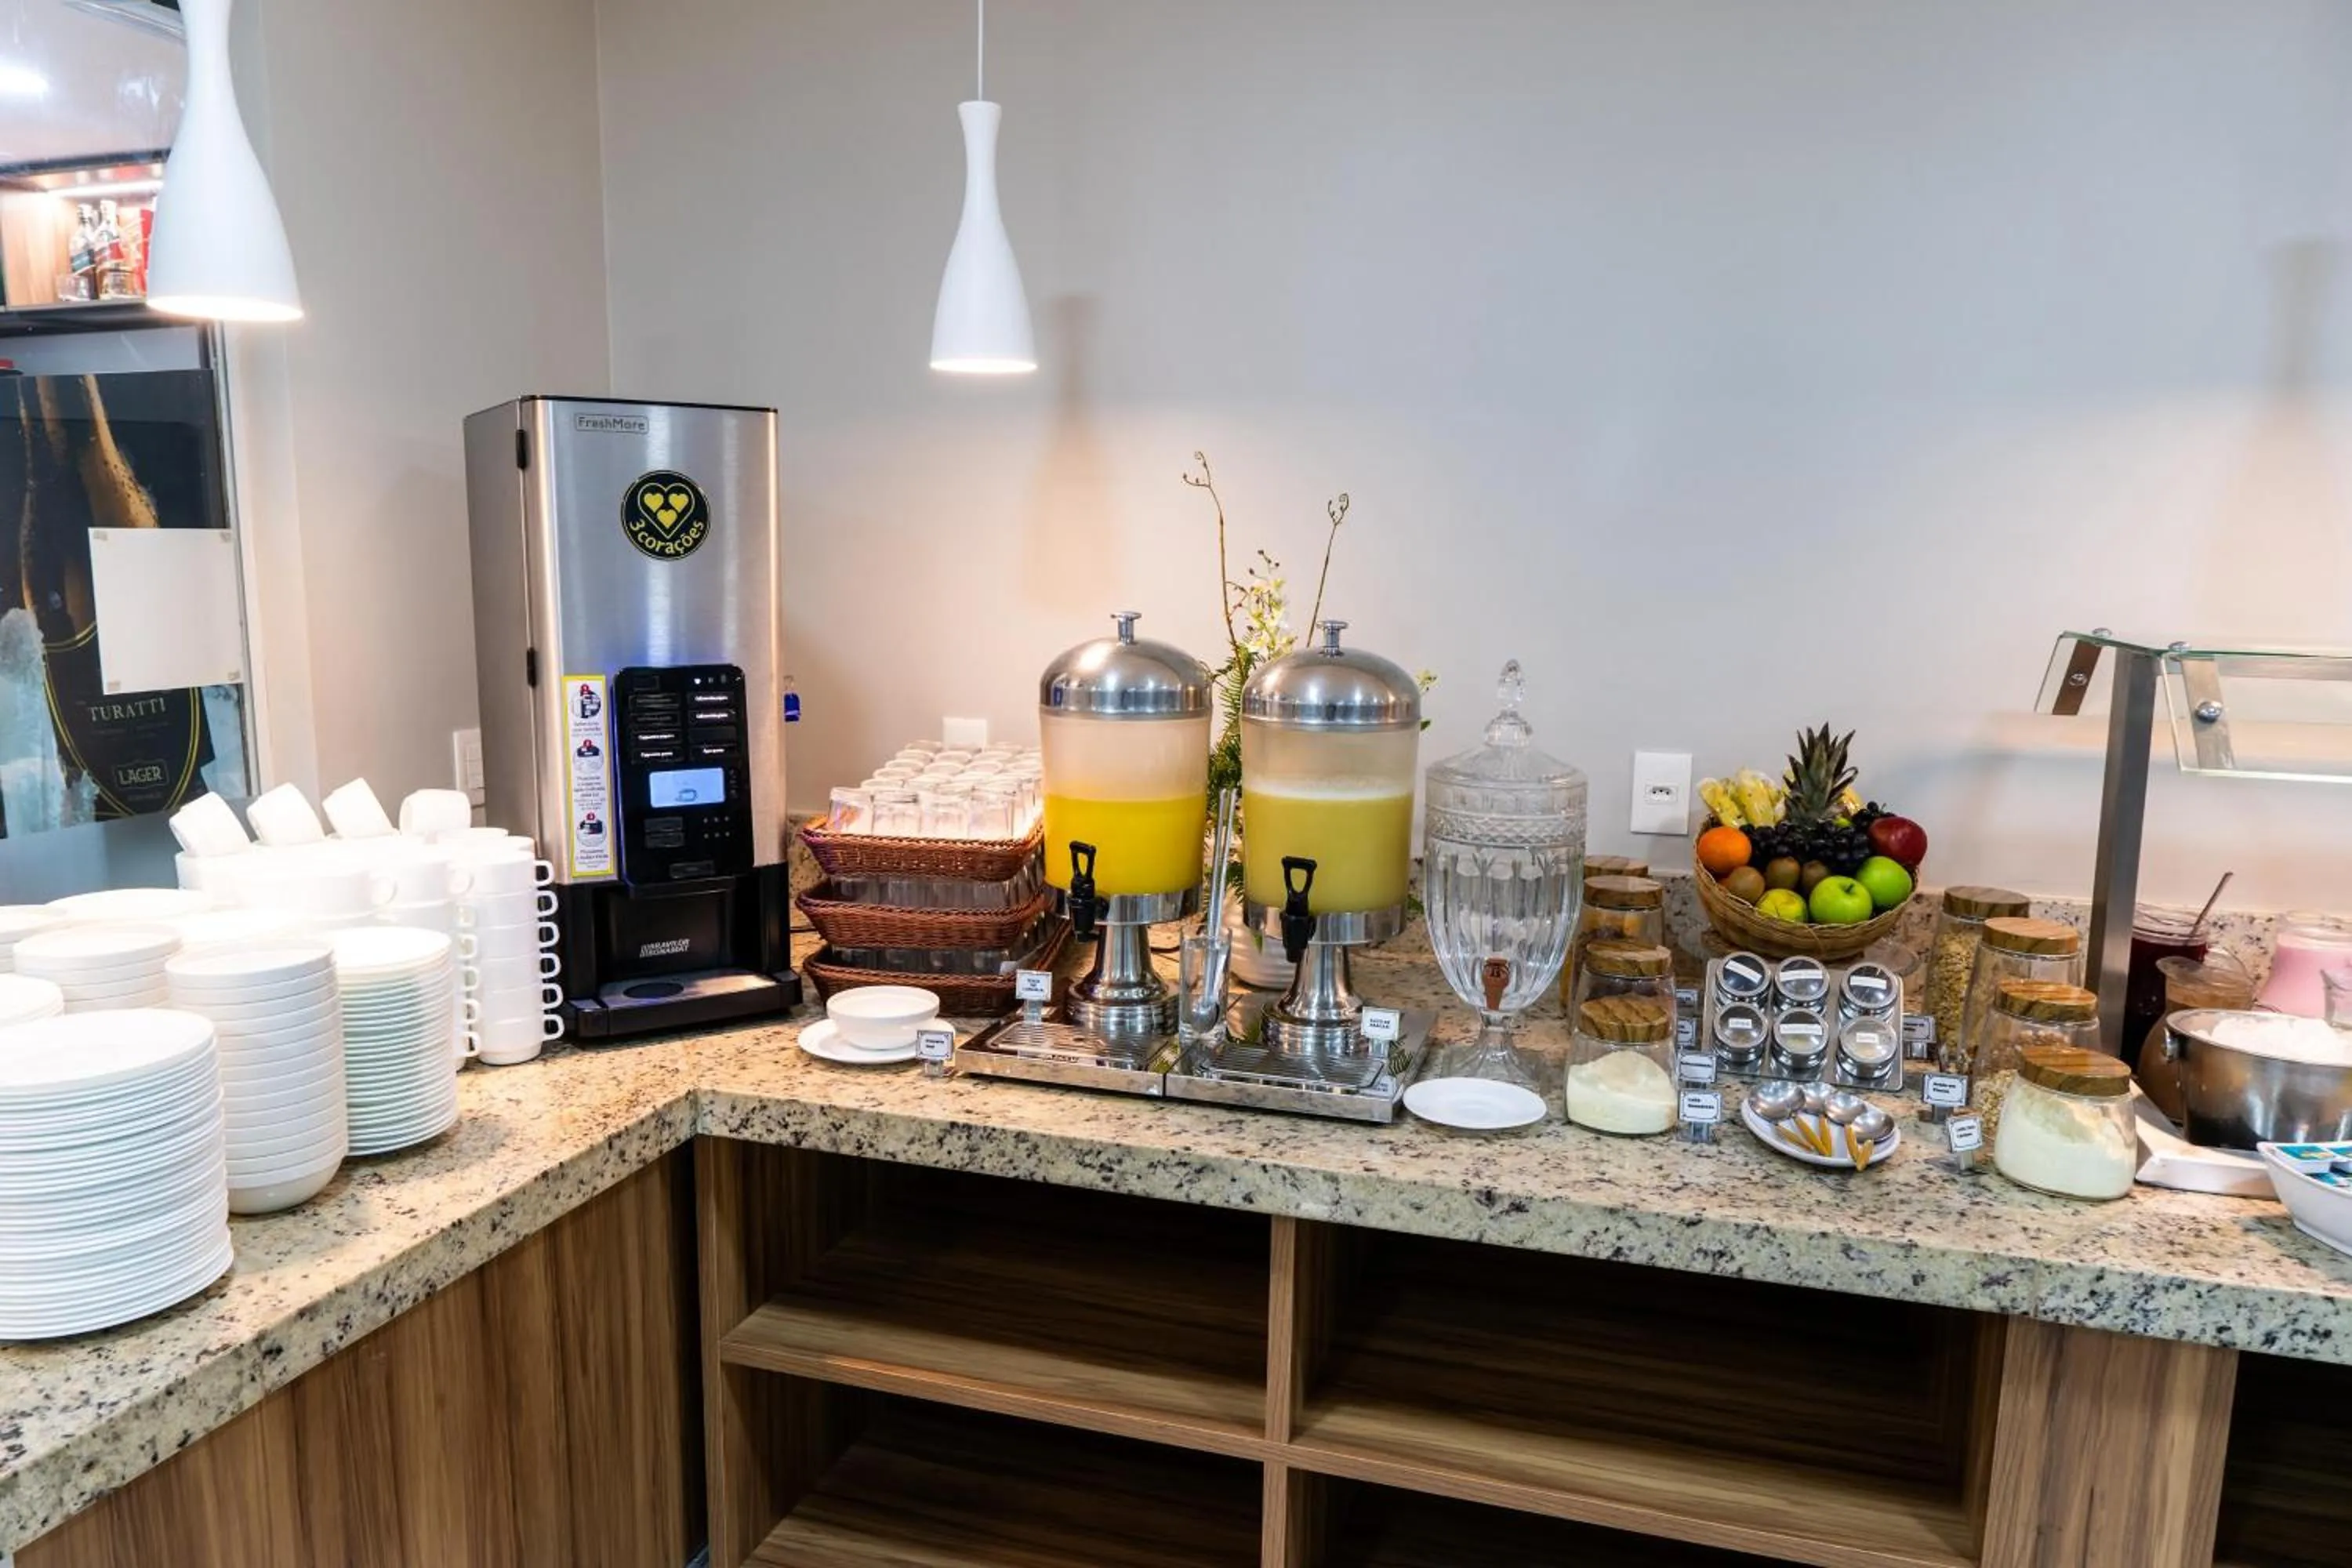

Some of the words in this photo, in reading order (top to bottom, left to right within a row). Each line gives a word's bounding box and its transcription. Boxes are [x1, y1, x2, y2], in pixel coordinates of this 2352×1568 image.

[579, 416, 645, 430] FreshMore
[630, 518, 646, 532] 3
[637, 521, 705, 554] corações
[87, 696, 167, 722] TURATTI
[118, 765, 163, 785] LAGER
